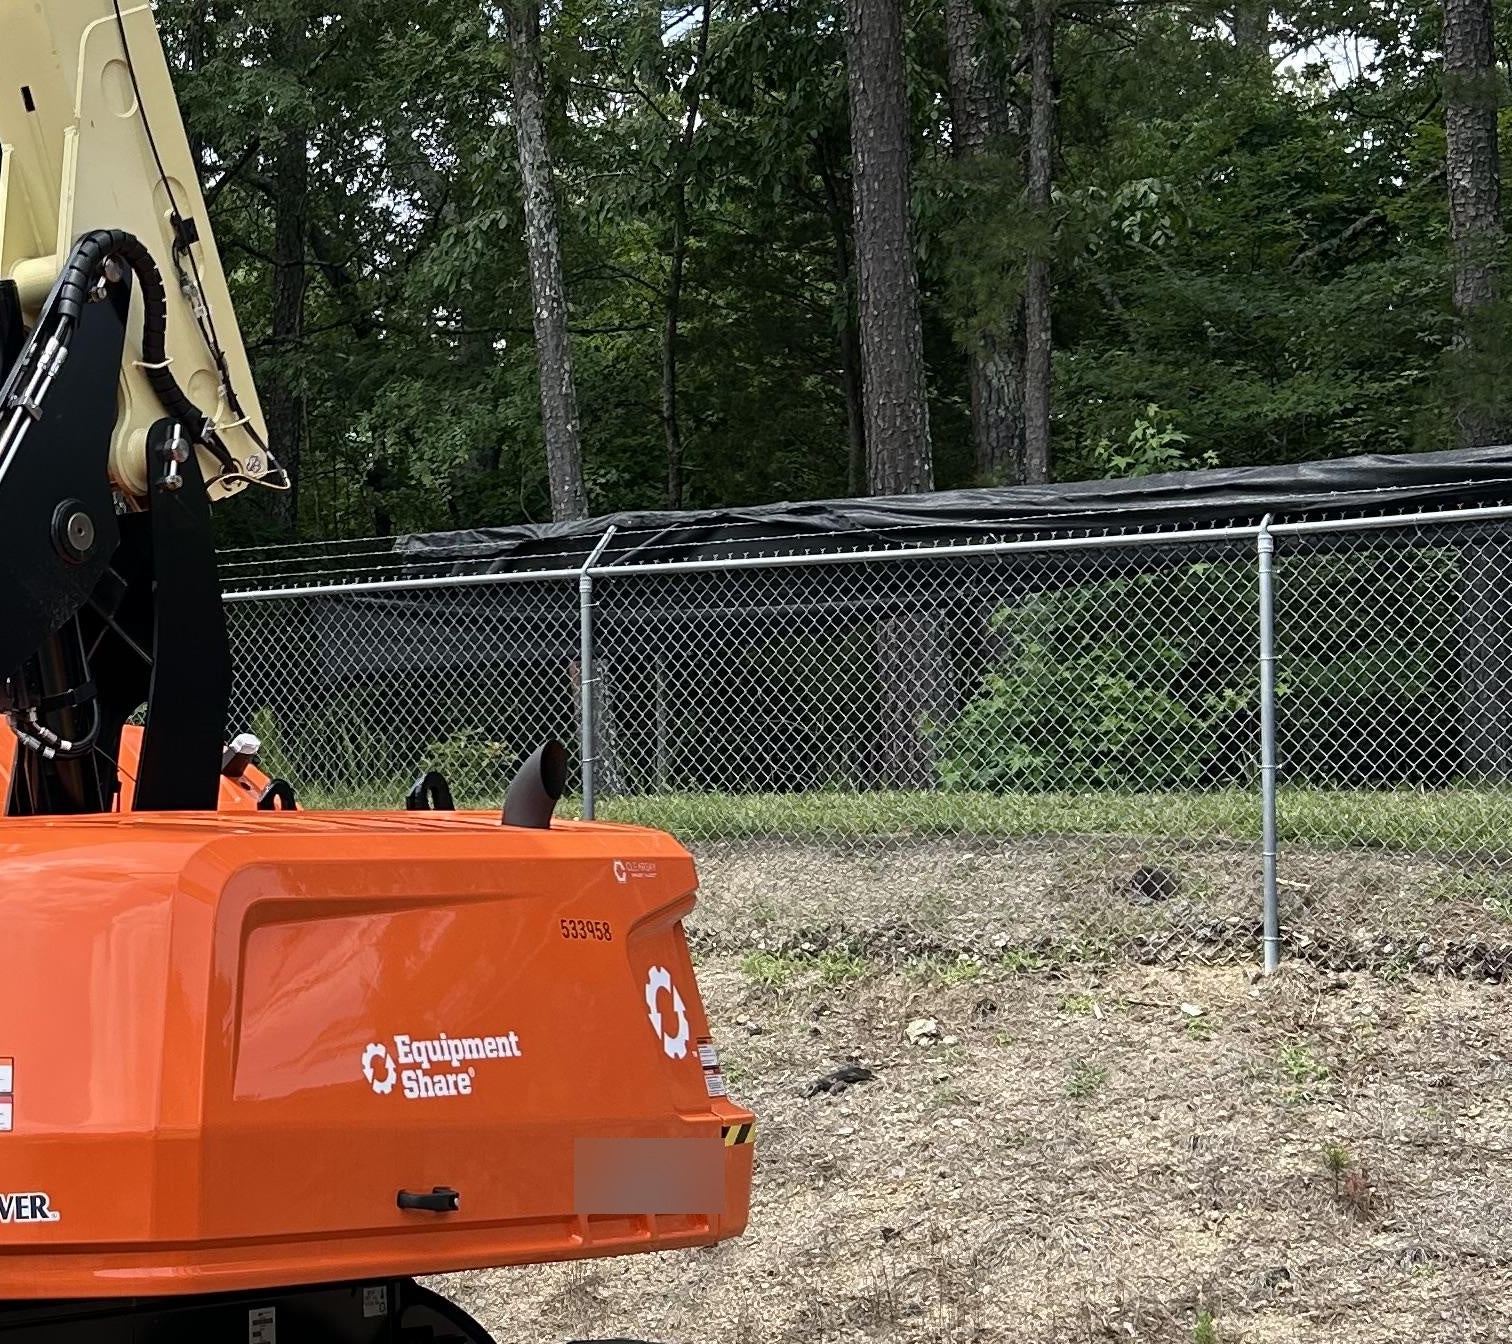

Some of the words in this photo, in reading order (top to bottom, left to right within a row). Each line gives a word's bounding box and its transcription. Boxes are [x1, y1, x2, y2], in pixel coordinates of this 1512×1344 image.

[560, 919, 612, 941] 533958
[394, 1030, 522, 1069] Equipment
[402, 1070, 473, 1099] Share
